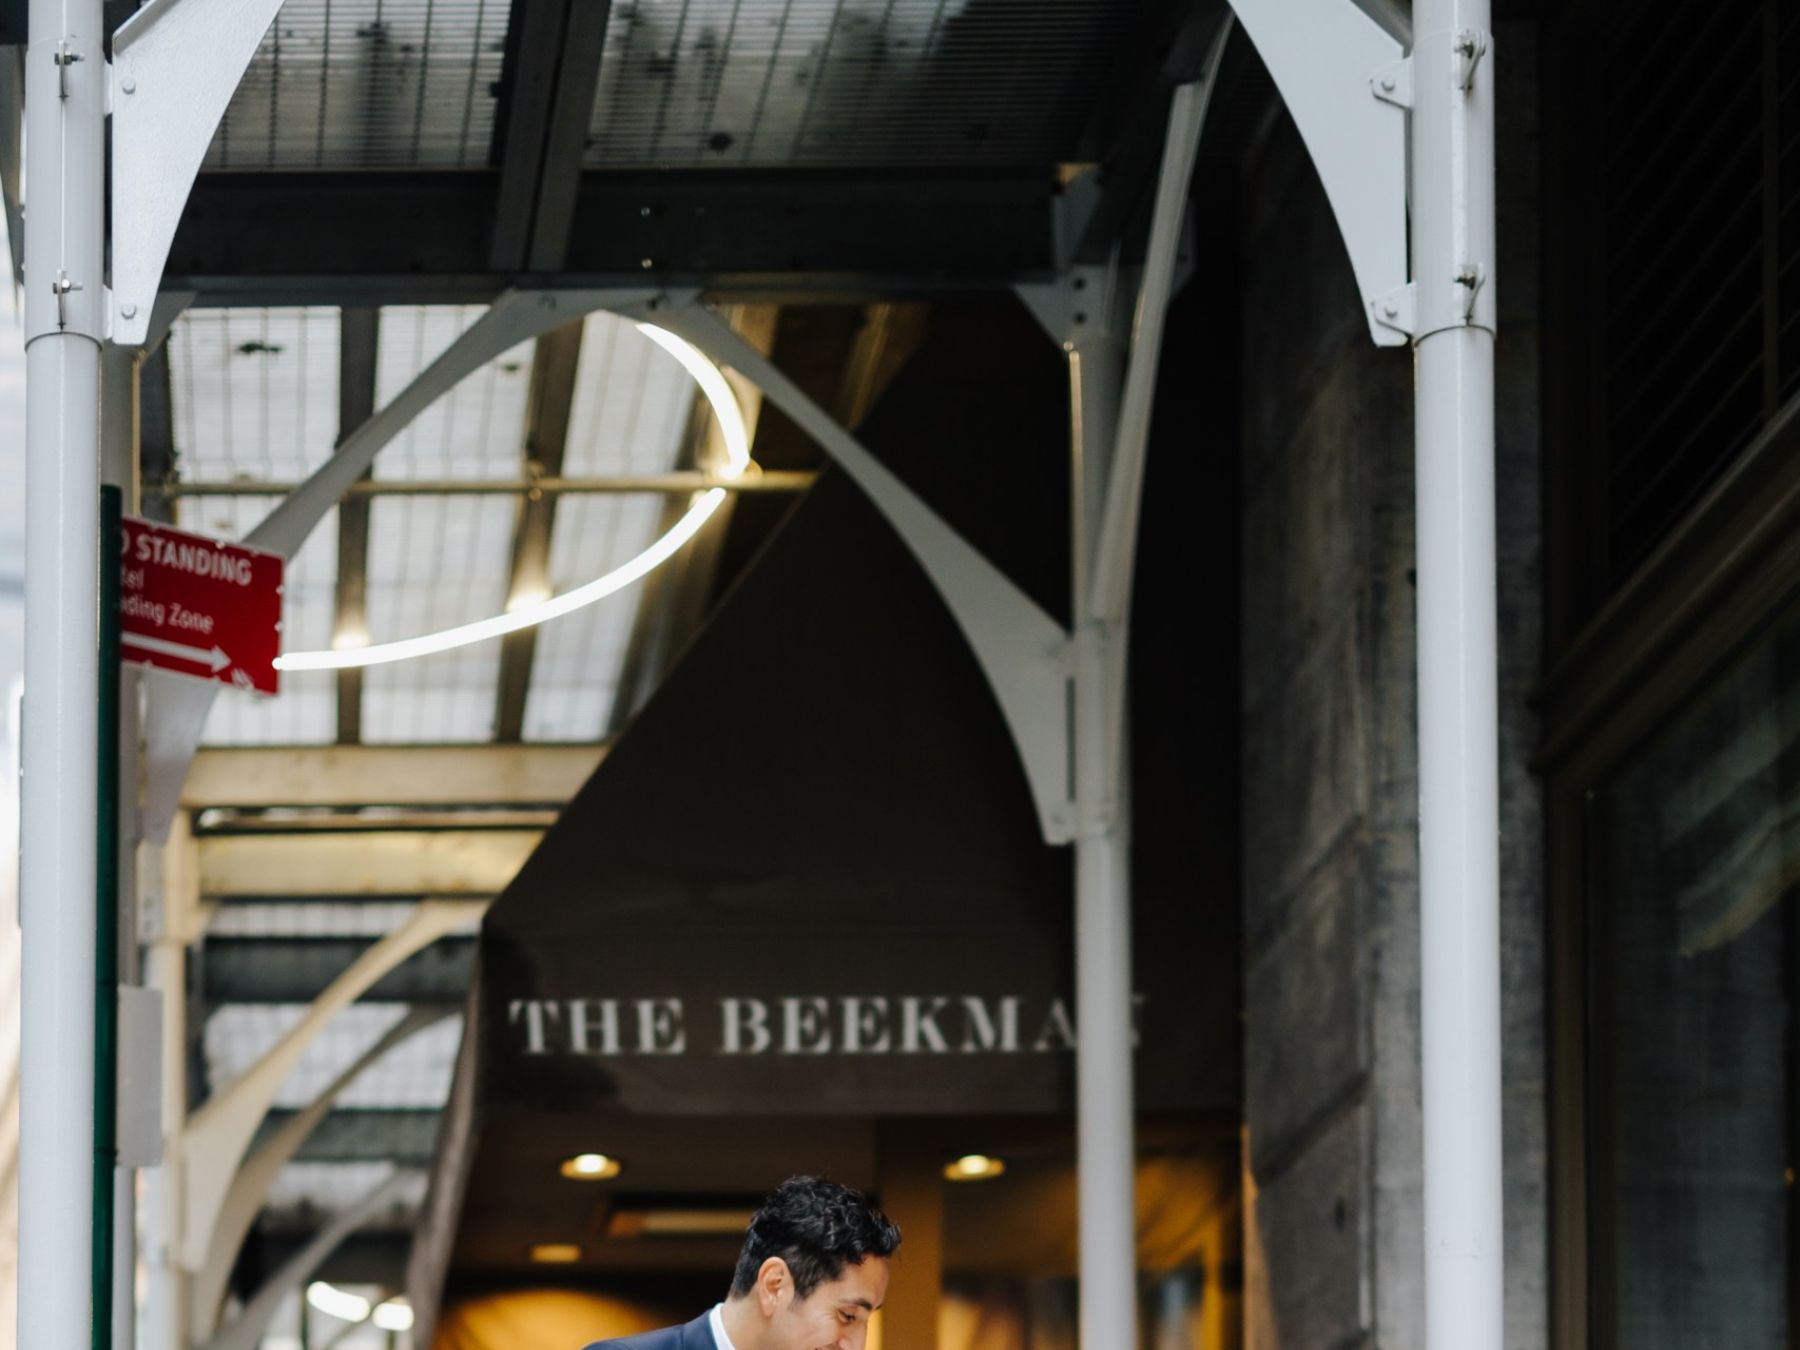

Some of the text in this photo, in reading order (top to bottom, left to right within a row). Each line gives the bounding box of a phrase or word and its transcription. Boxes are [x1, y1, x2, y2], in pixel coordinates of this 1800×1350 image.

[136, 534, 252, 586] STANDING
[168, 602, 214, 633] Zone
[509, 996, 1146, 1053] THE BEEKMA
